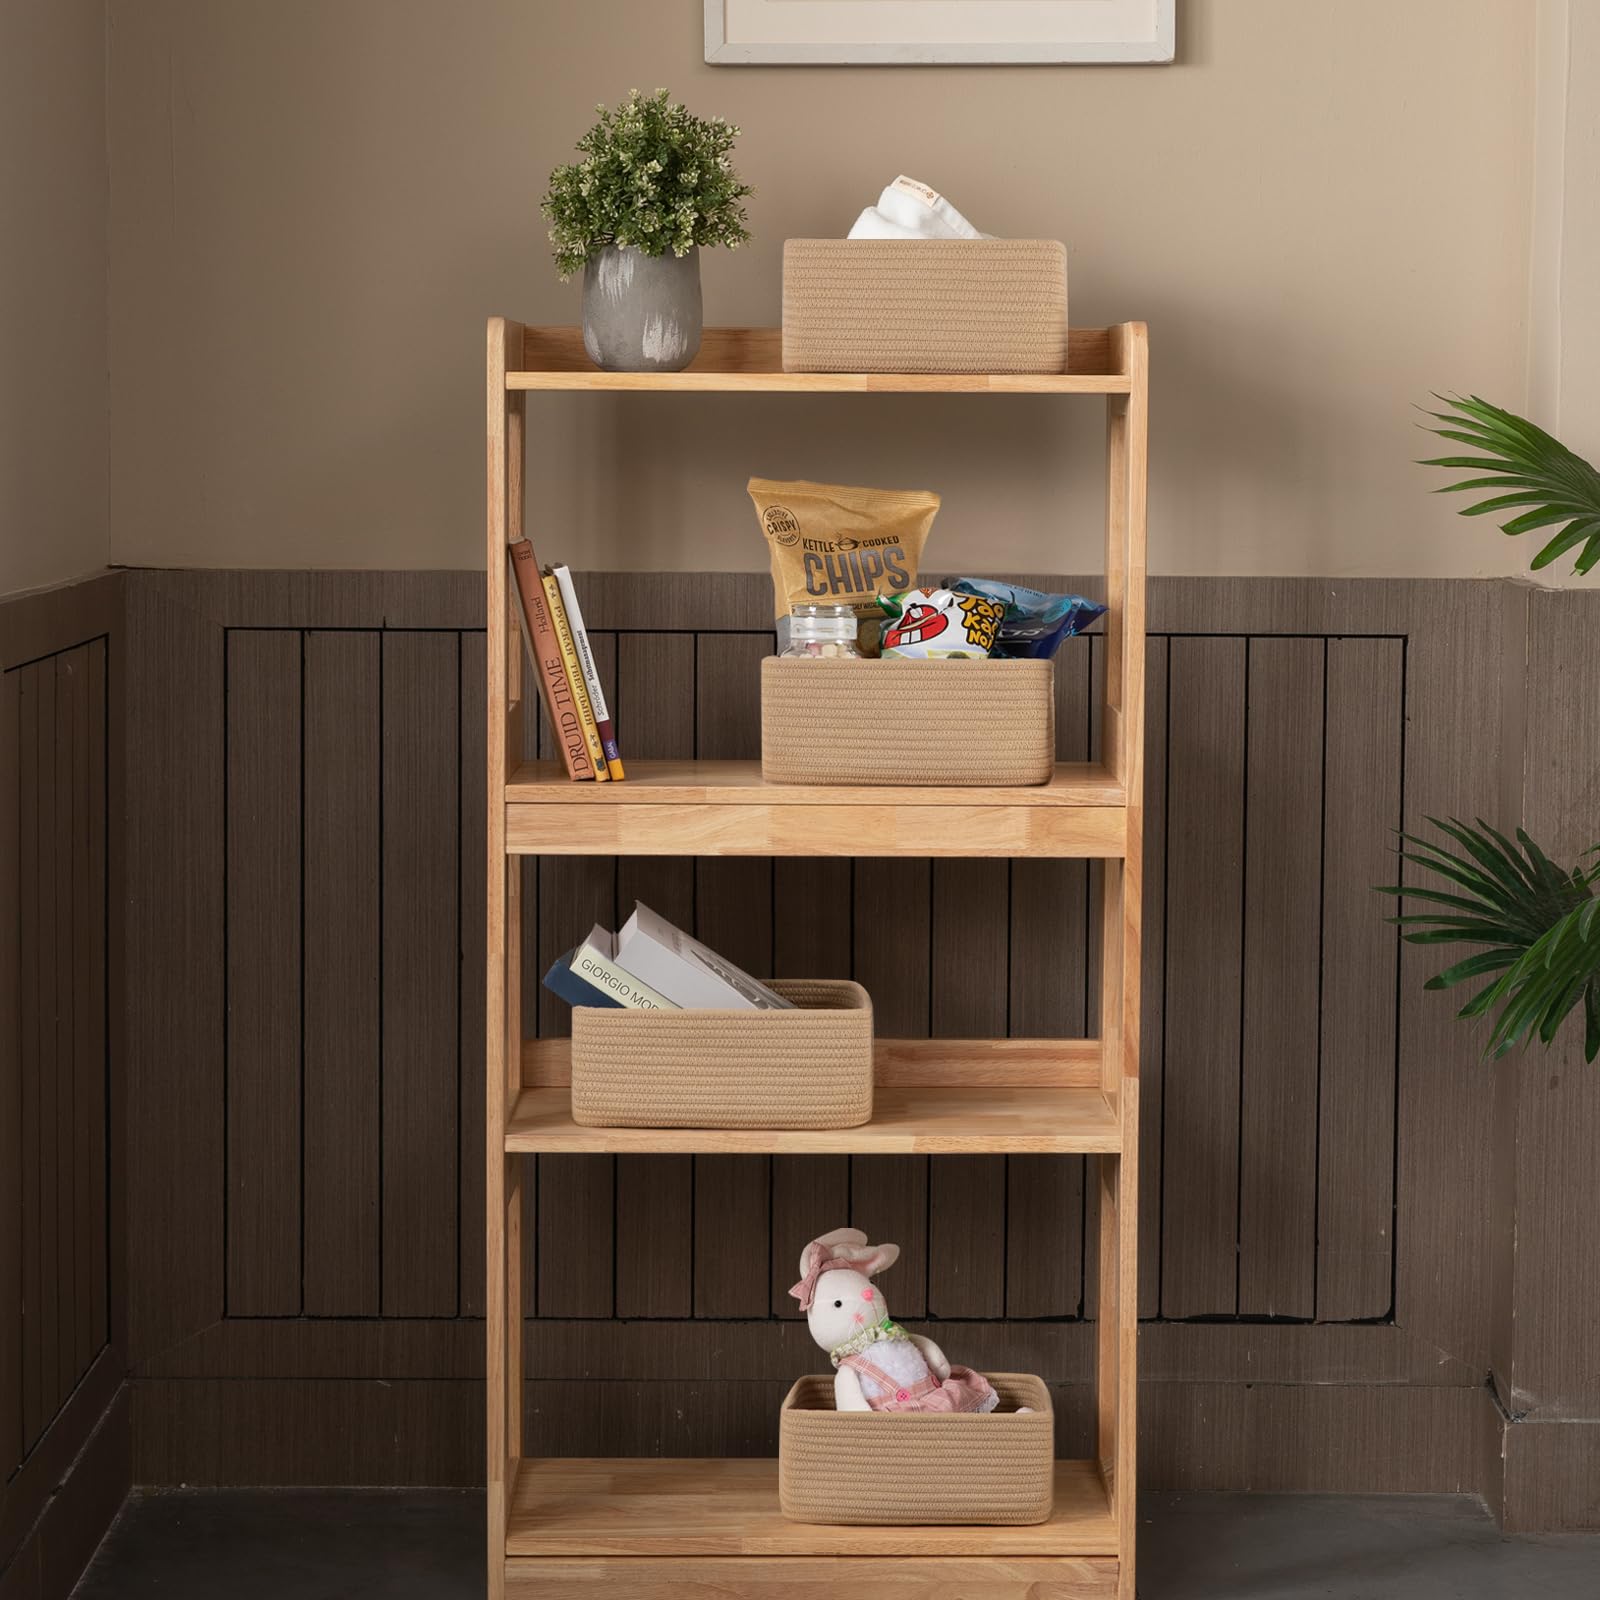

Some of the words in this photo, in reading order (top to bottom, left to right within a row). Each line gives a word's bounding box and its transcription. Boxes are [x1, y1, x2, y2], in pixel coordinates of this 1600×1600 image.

[766, 520, 796, 535] CRISPY
[802, 537, 835, 553] KETTLE
[862, 535, 900, 548] COOKED
[803, 546, 910, 597] CHIPS
[532, 597, 549, 633] Holland
[545, 656, 571, 710] TIME
[554, 605, 574, 656] РУССКАЯ
[571, 662, 593, 726] ТВЕРДЫНЯ
[561, 711, 590, 772] DRUID
[581, 958, 630, 997] GIORGIO
